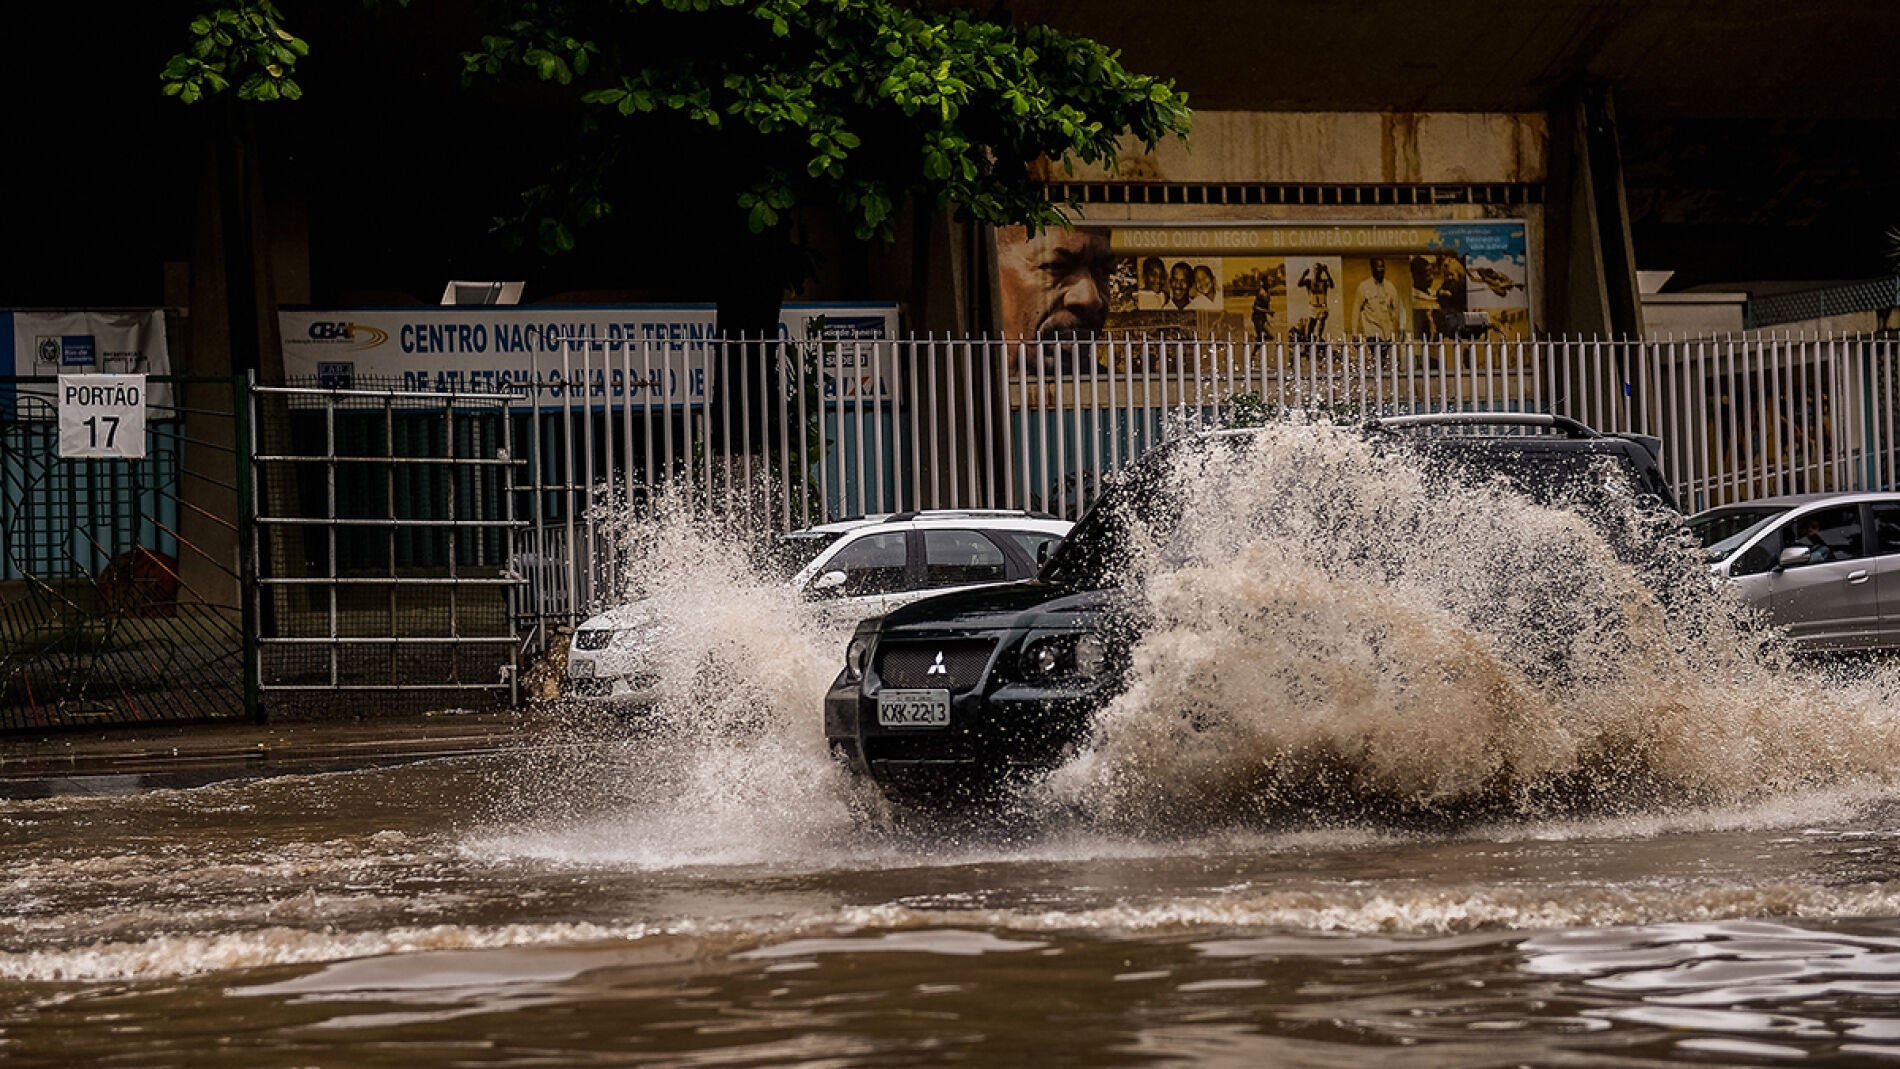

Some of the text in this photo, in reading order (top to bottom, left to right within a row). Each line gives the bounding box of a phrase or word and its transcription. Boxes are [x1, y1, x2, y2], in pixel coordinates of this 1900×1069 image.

[1123, 230, 1168, 247] NOSSO
[1172, 230, 1209, 247] OURO
[1214, 230, 1258, 247] NEGRO
[400, 323, 487, 353] CENTRO
[495, 323, 603, 353] NACIONAL
[609, 323, 636, 351] DE
[66, 382, 139, 406] PORTÃO
[83, 416, 120, 448] 17
[881, 702, 946, 721] KXK-2213
